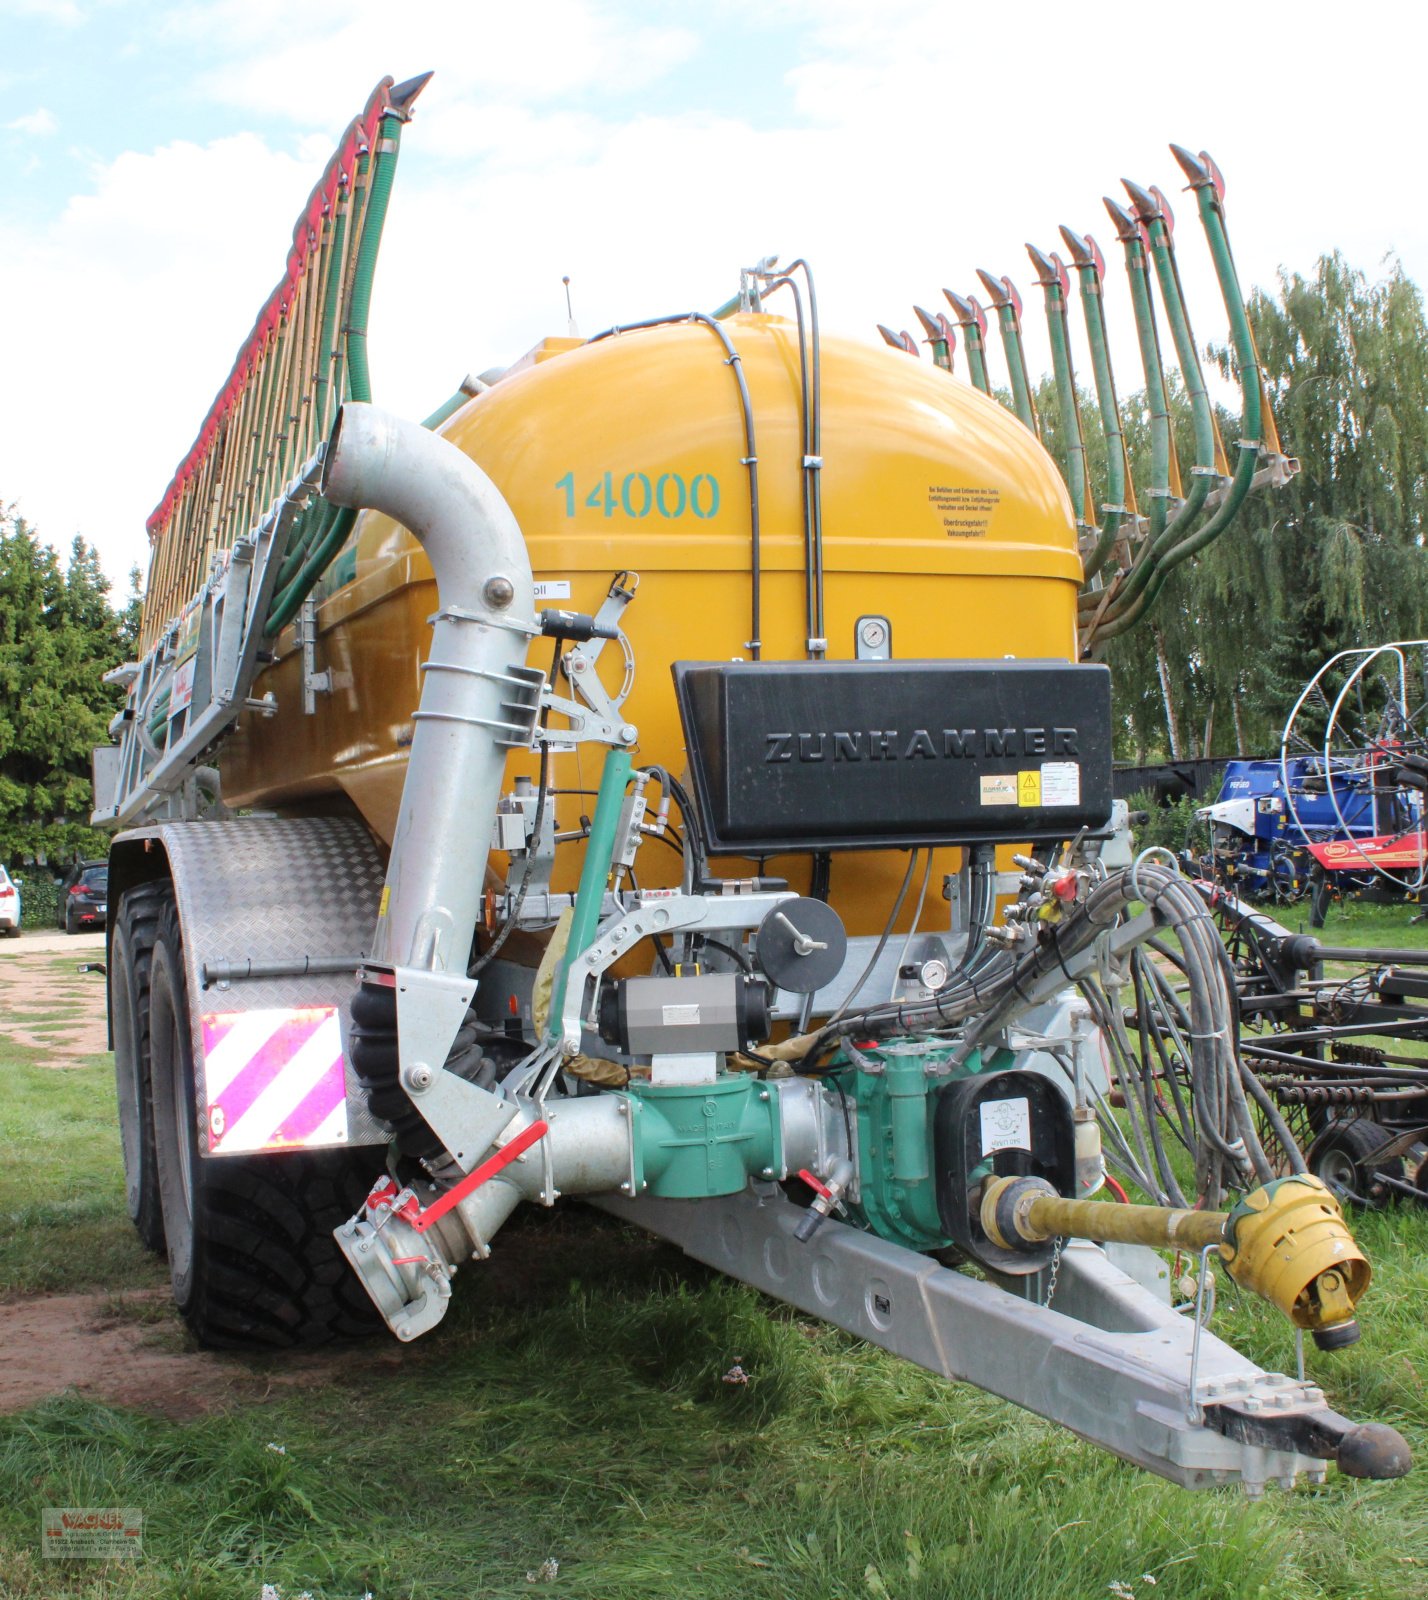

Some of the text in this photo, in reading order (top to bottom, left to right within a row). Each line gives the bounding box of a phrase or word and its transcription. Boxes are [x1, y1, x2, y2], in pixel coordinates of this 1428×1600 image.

[555, 471, 720, 518] 14000
[534, 585, 546, 595] oll
[765, 727, 1079, 763] ZUNHAMMER
